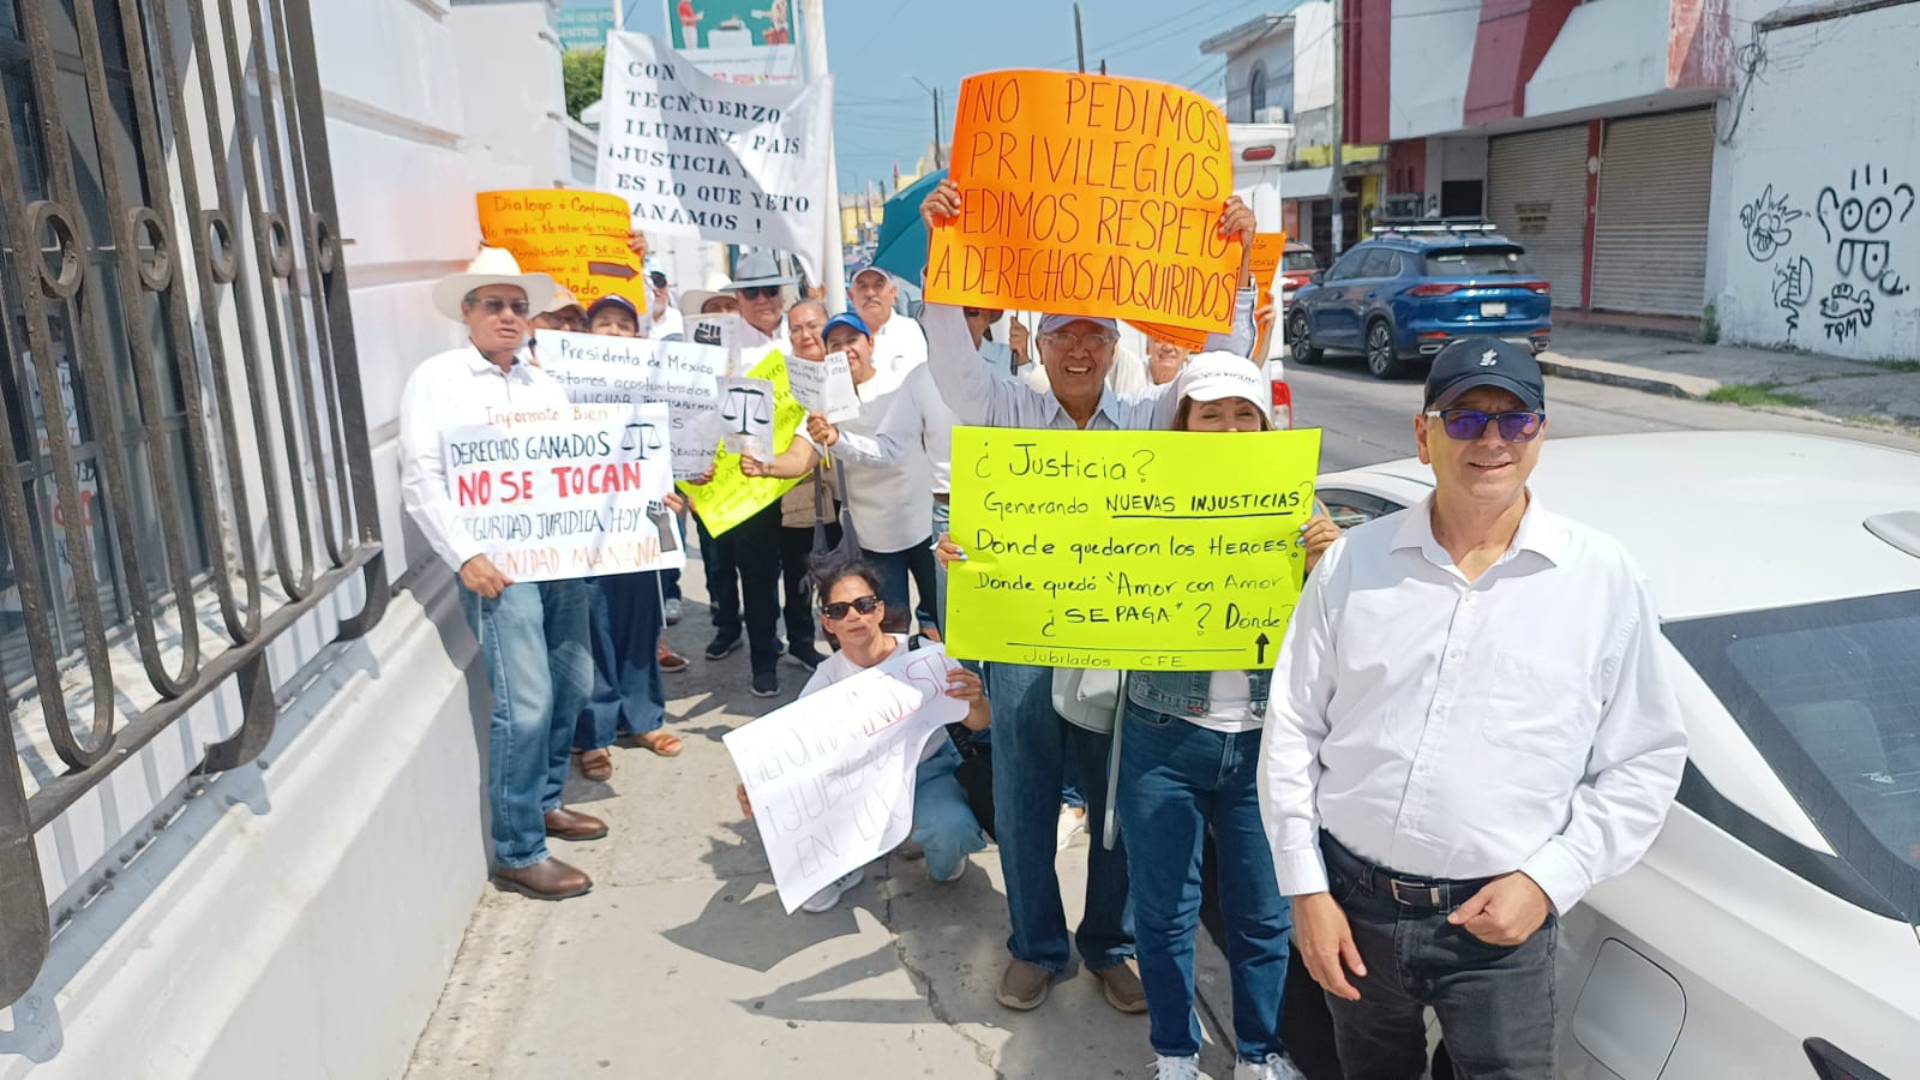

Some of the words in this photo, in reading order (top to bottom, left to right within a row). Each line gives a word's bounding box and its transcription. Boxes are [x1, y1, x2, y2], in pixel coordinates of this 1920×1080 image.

[628, 61, 676, 81] CON
[1065, 78, 1222, 153] PEDIMOS
[608, 144, 731, 176] ¡JUSTICIA
[753, 135, 800, 155] PAIS
[970, 131, 1220, 201] PRIVILEGIOS
[617, 173, 647, 191] ES
[657, 180, 686, 198] LO
[697, 185, 742, 205] QUE
[493, 196, 552, 219] Dialogo
[633, 202, 739, 231] ANAMOS
[1096, 195, 1232, 259] RESPETO
[931, 243, 951, 290] A
[962, 244, 1095, 303] DERECHOS
[1824, 317, 1857, 344] TQM
[561, 338, 640, 366] Presidenta
[647, 352, 662, 368] de
[450, 437, 519, 468] DERECHOS
[525, 431, 612, 461] GANADOS
[1008, 443, 1155, 484] Justicia?
[458, 470, 492, 507] NO
[499, 470, 534, 504] SE
[551, 462, 642, 499] TOCAN
[983, 490, 1089, 520] Generando
[1105, 494, 1176, 513] NUEVAS
[1190, 480, 1315, 515] INJUSTICIAS?
[608, 506, 641, 534] HOY
[1069, 536, 1161, 564] quedaron
[1169, 536, 1195, 557] los
[1185, 581, 1215, 592] con
[1224, 574, 1285, 591] Amor
[1064, 608, 1110, 623] SE
[1023, 649, 1112, 667] Jubilados
[1139, 654, 1186, 667] CFE
